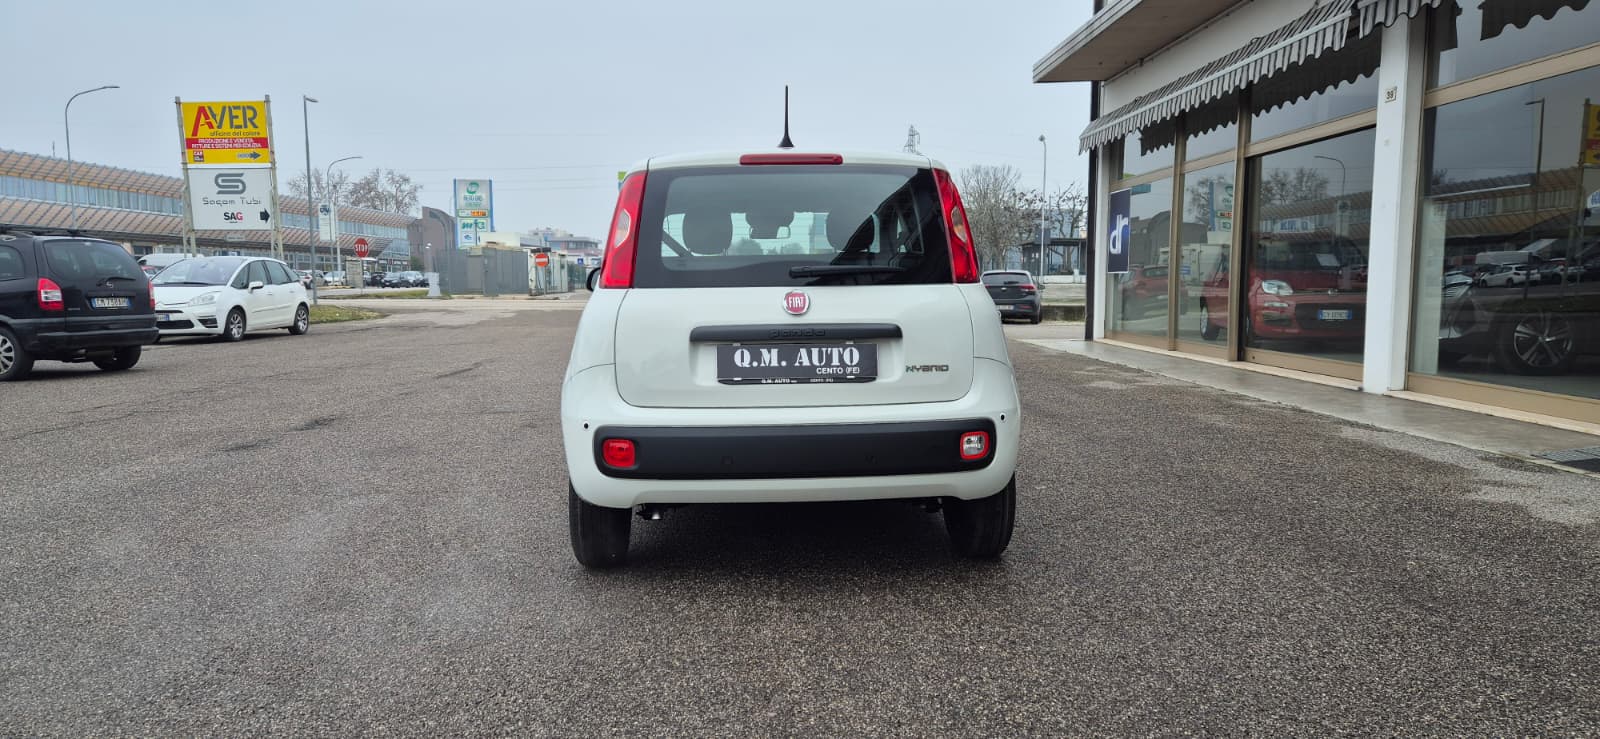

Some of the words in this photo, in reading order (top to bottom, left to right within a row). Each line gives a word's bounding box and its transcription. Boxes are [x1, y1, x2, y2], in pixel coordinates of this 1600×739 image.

[192, 105, 259, 137] AVER
[223, 212, 243, 220] SAG
[1110, 214, 1129, 255] dr
[354, 243, 368, 253] STOP
[788, 296, 805, 308] FIAT
[768, 328, 826, 339] panda
[733, 348, 787, 368] Q.M.
[795, 347, 860, 367] AUTO
[816, 367, 844, 375] CENTO
[845, 366, 860, 375] (FE)
[905, 364, 949, 373] HYBRID
